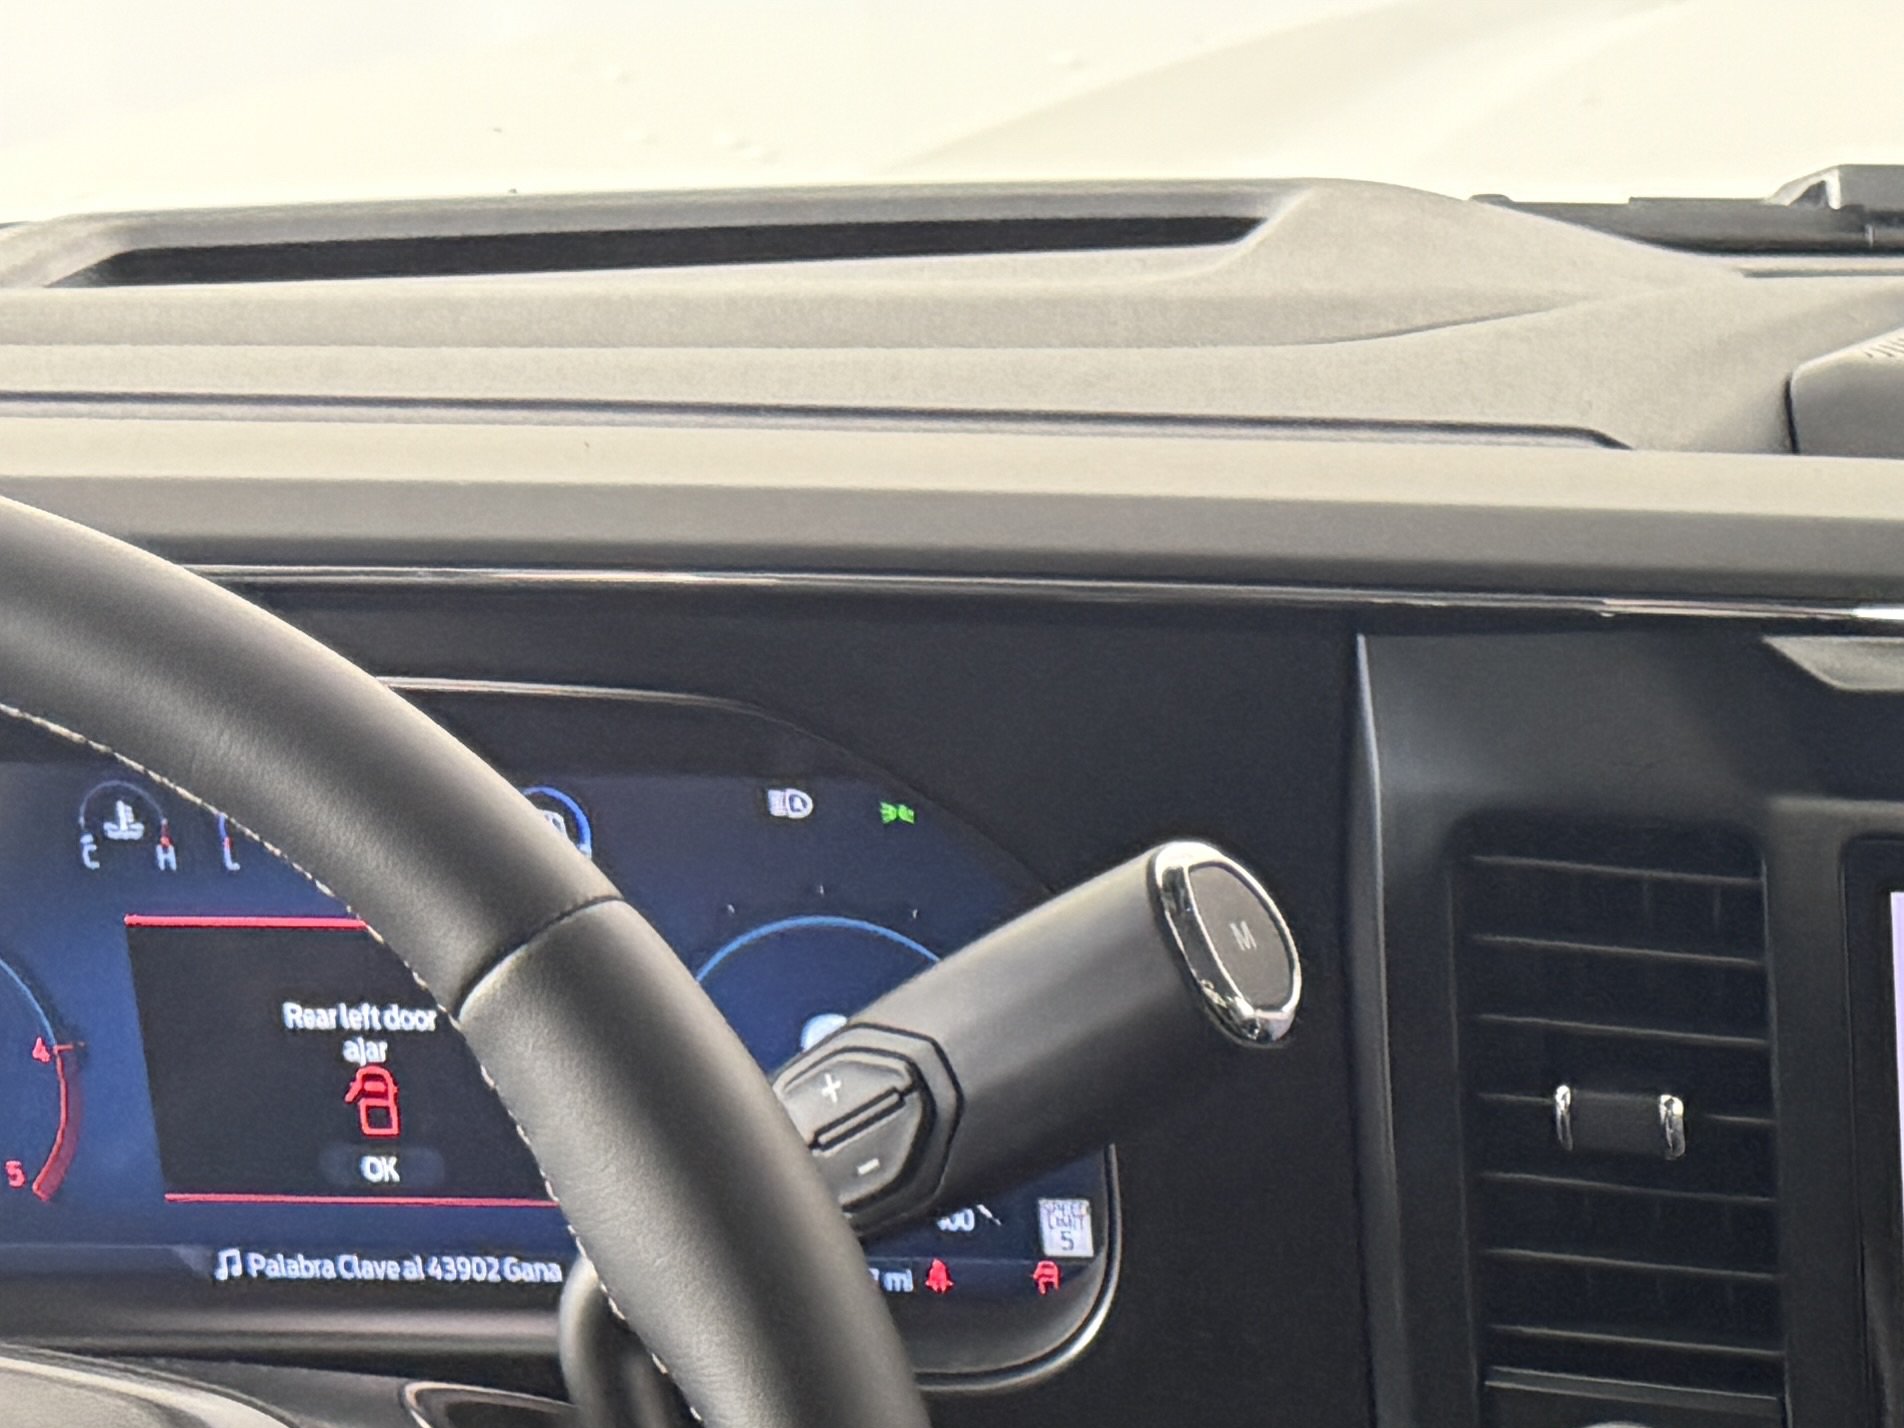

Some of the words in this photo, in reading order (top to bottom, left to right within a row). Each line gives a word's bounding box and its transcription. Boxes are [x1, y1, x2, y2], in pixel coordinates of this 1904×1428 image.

[156, 844, 177, 870] H
[283, 1002, 337, 1030] Rear
[340, 1003, 381, 1030] left
[383, 1004, 437, 1031] door
[32, 1036, 51, 1062] 4
[343, 1037, 388, 1065] ajar
[5, 1160, 26, 1188] 5
[360, 1156, 400, 1182] OK
[1060, 1231, 1075, 1251] 5
[247, 1253, 336, 1280] Palabra
[337, 1254, 401, 1280] Clave
[403, 1256, 425, 1281] al
[426, 1256, 501, 1282] 43902
[503, 1257, 563, 1283] Gana
